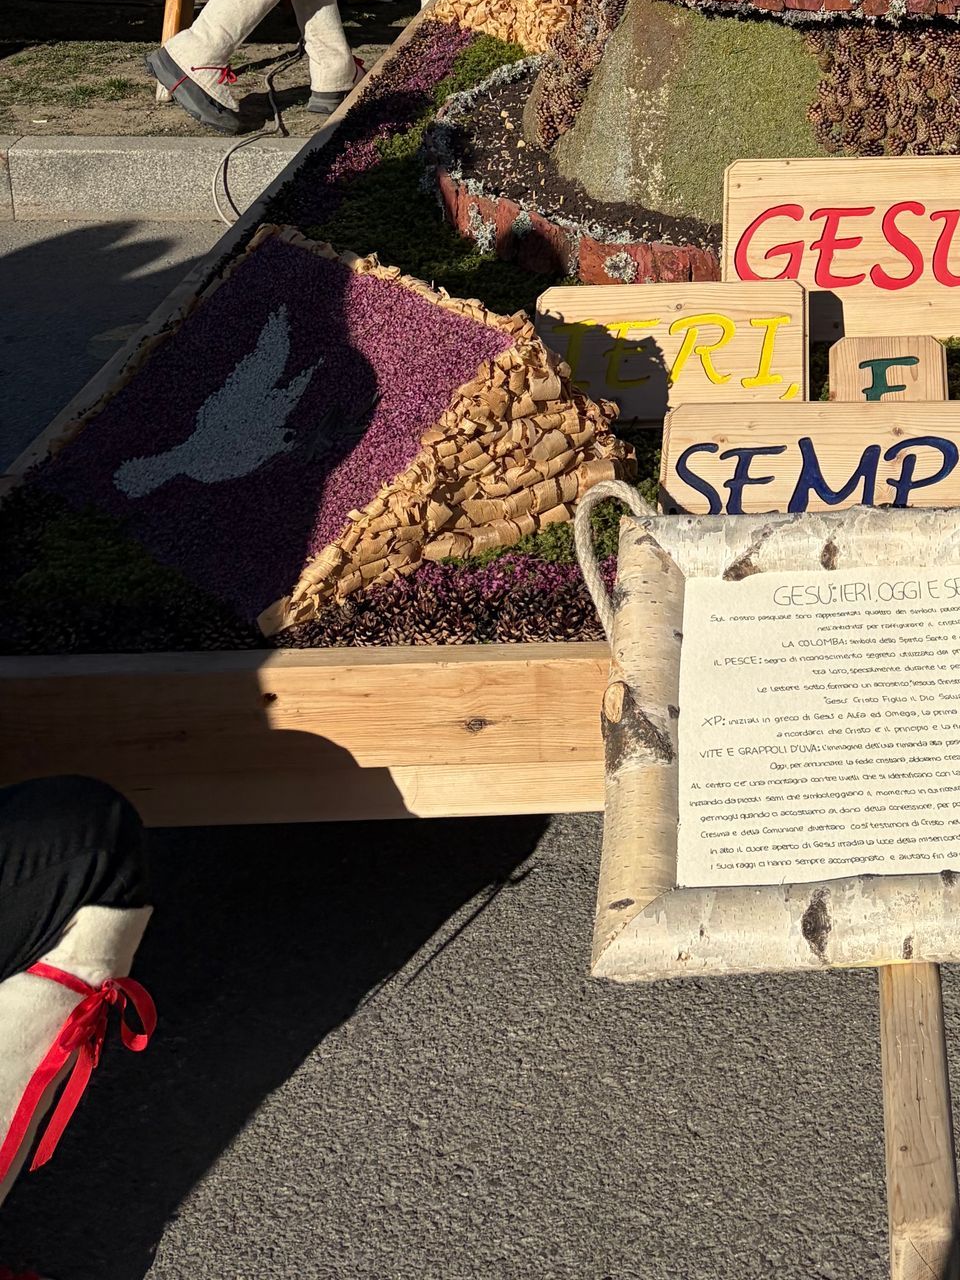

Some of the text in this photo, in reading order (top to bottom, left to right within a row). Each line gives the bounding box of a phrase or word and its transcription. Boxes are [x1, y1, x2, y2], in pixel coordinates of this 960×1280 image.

[553, 313, 799, 401] IERI,
[877, 581, 921, 601] OGGI
[927, 579, 939, 598] E
[709, 613, 726, 623] Sul
[728, 614, 756, 622] nostro
[756, 613, 792, 622] pasquale
[865, 623, 879, 631] per
[780, 640, 795, 649] LA
[797, 636, 848, 648] COLOMBA:
[723, 654, 762, 666] PESCE:
[763, 656, 787, 665] segno
[865, 651, 896, 660] segreto
[903, 664, 936, 672] durante
[769, 684, 800, 692] lettere
[826, 681, 859, 690] formano
[851, 693, 935, 704] Cristo Figlio Dio
[727, 716, 760, 725] iniziali
[773, 714, 800, 724] greco
[869, 710, 882, 718] ed
[931, 708, 958, 717] prima
[826, 727, 843, 735] che
[844, 726, 872, 735] Cristo
[698, 747, 723, 759] VITE
[737, 744, 788, 756] GRAPPOLI
[789, 742, 821, 754] D'UVA:
[788, 761, 802, 770] per
[704, 781, 732, 789] centro
[748, 779, 766, 787] una
[934, 770, 951, 778] con
[723, 796, 737, 805] da
[764, 794, 785, 802] semi
[874, 788, 916, 796] momento
[738, 810, 771, 820] quando
[838, 806, 861, 814] dono
[935, 801, 950, 810] per
[699, 829, 730, 839] Cresima
[761, 824, 804, 835] Comunione
[919, 817, 945, 827] Cristo
[875, 837, 895, 845] luce
[766, 858, 792, 867] hanno
[793, 856, 826, 866] sempre
[945, 850, 959, 859] da
